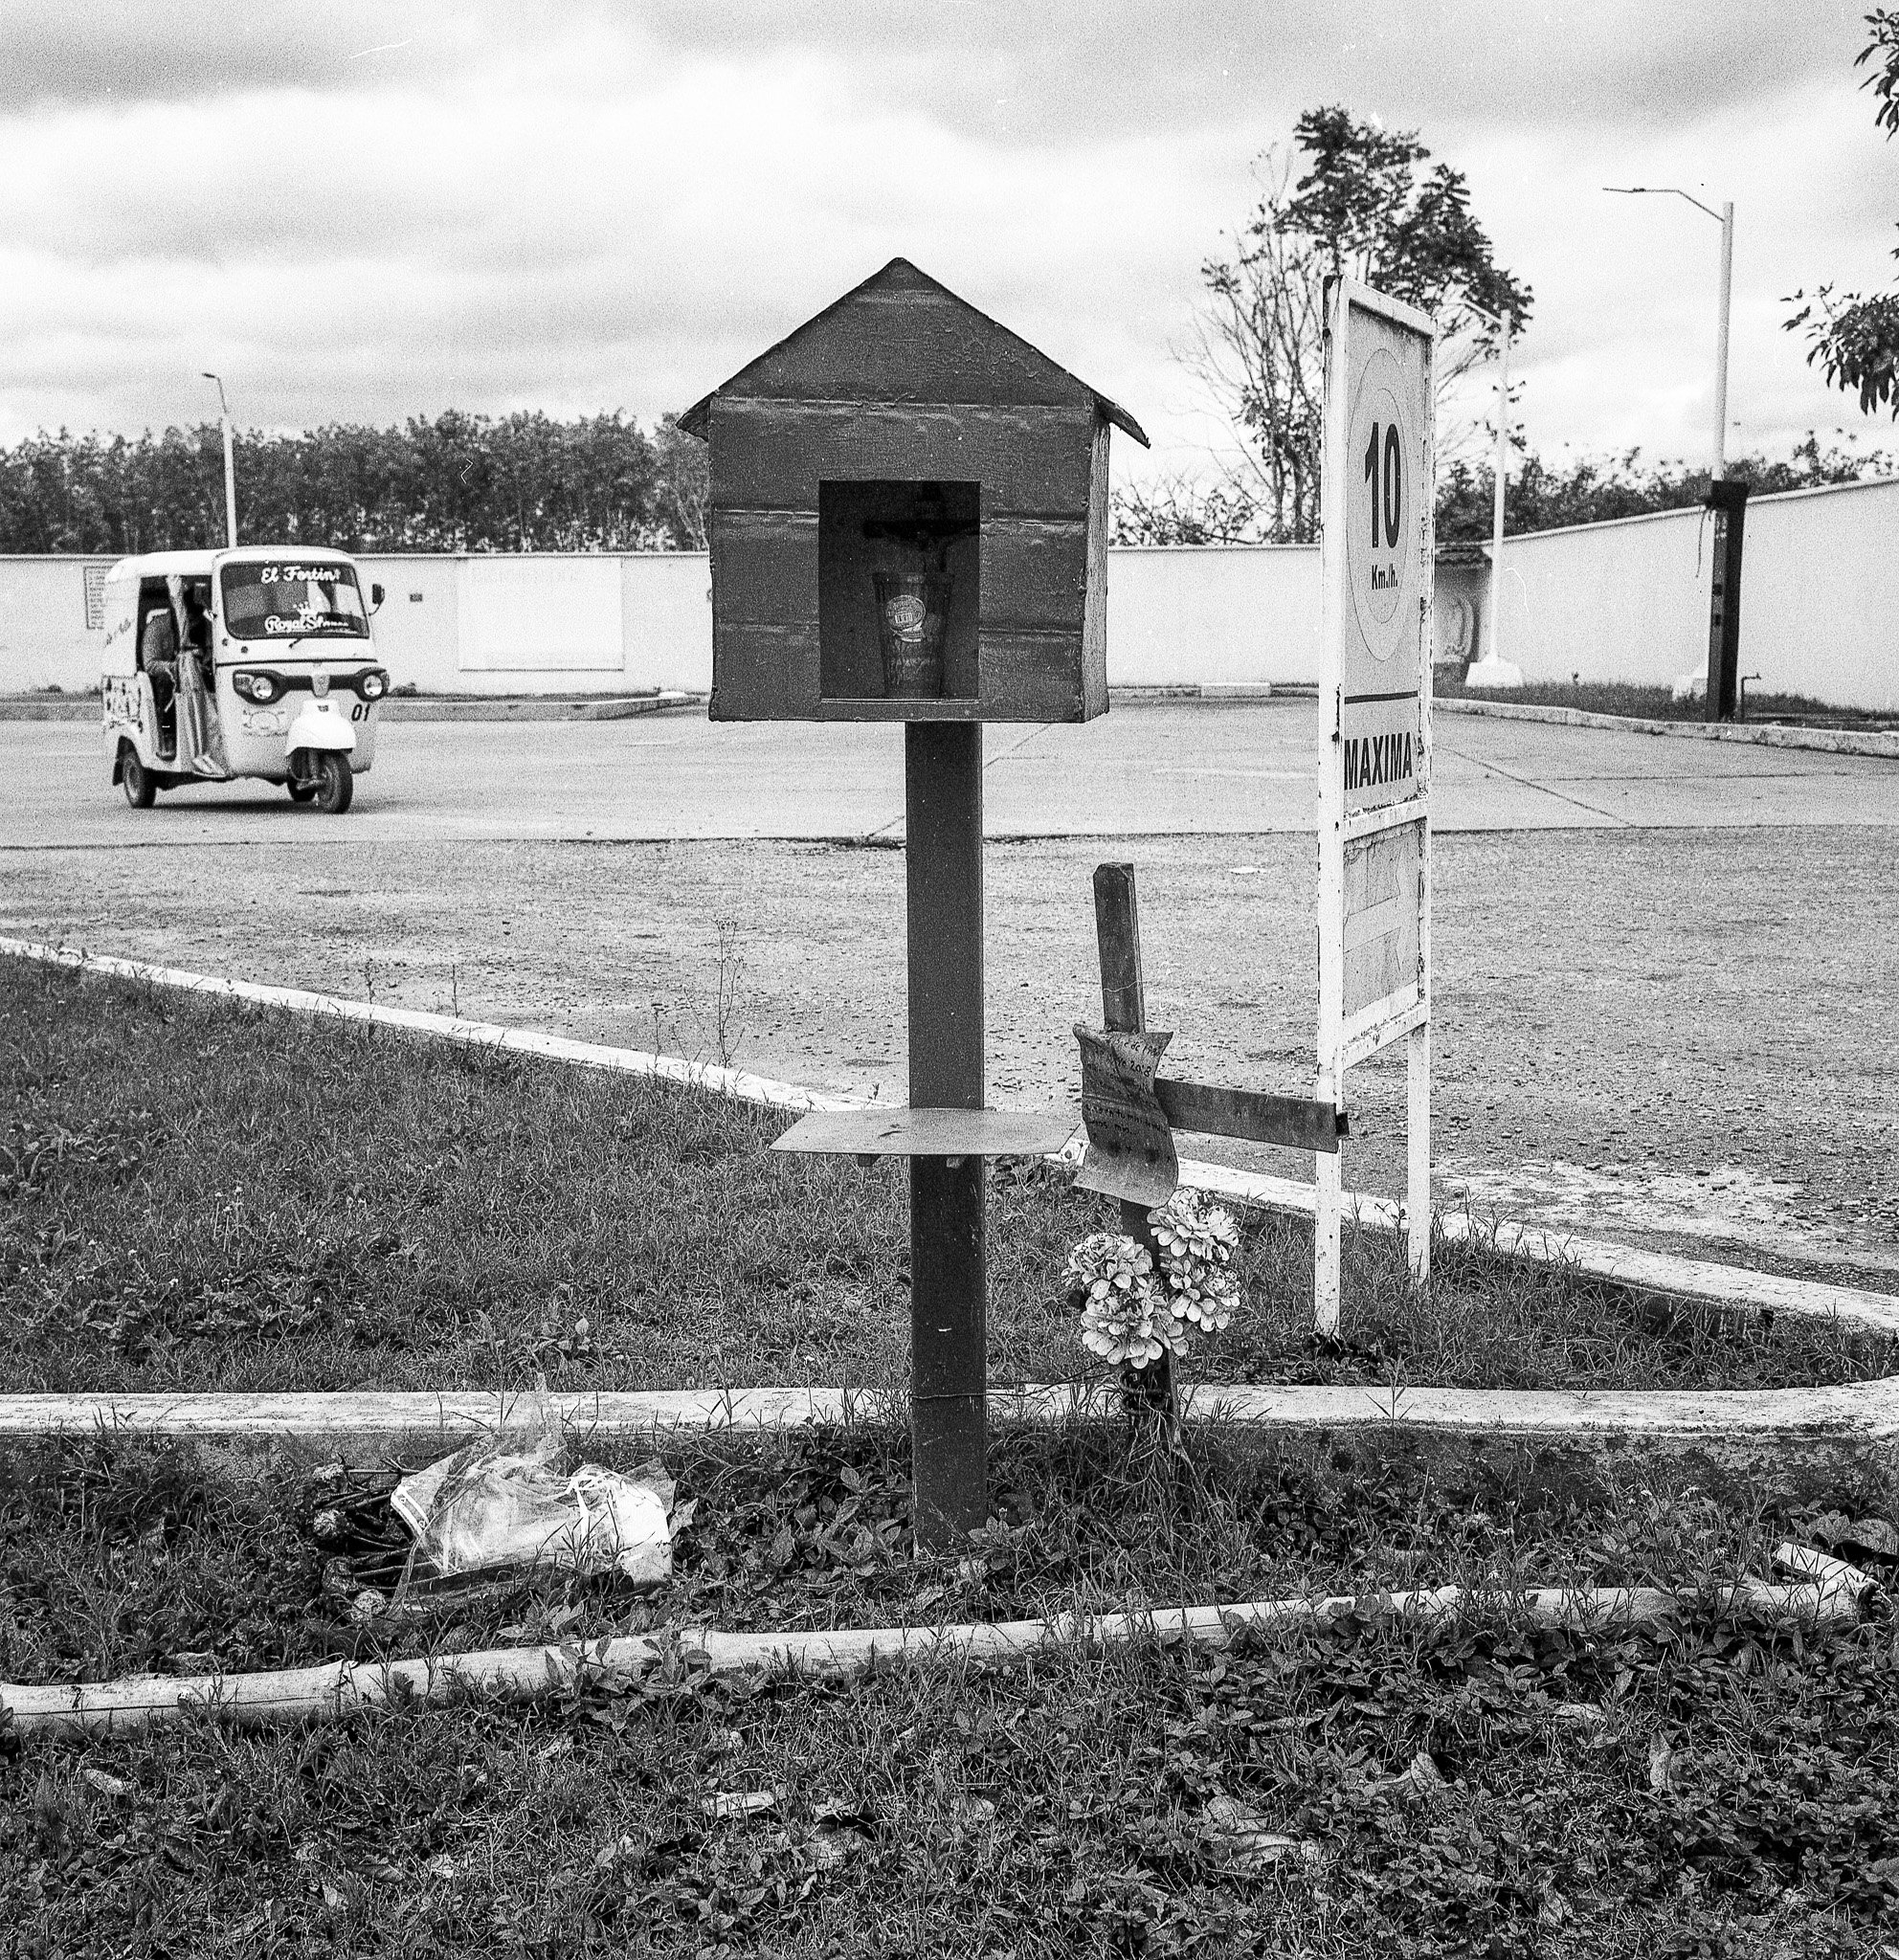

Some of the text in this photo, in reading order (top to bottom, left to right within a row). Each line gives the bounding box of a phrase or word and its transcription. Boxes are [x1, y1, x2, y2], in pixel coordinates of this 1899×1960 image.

[1364, 421, 1401, 549] 10
[260, 567, 279, 584] El
[264, 614, 306, 634] Royal
[351, 703, 370, 722] 01
[1344, 731, 1413, 791] MAXIMA
